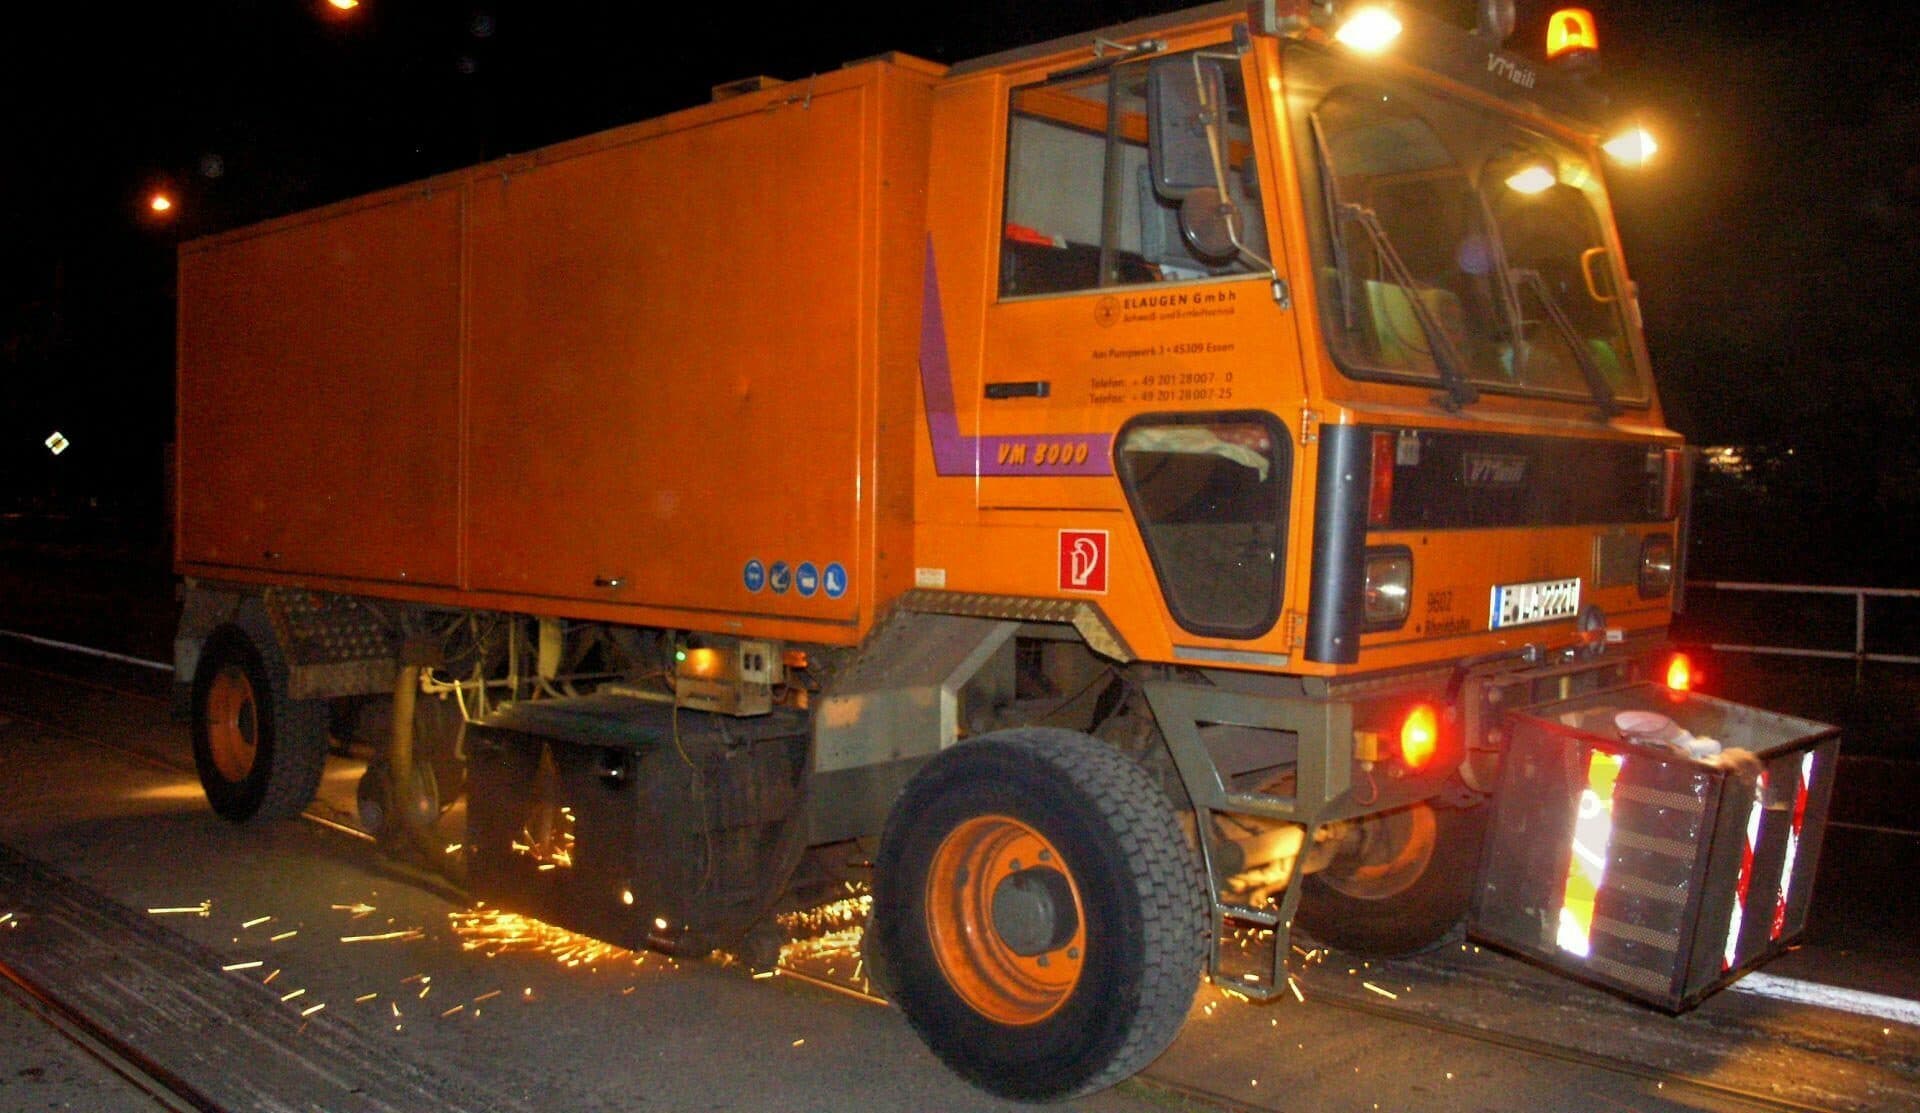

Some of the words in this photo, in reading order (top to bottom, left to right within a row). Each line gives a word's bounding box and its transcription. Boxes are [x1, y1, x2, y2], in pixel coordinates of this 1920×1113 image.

[1124, 293, 1188, 310] ELAUGEN
[1206, 341, 1235, 352] Essen
[1141, 374, 1155, 386] 49
[1157, 373, 1176, 386] 201
[997, 441, 1028, 466] VM
[1033, 440, 1090, 467] 8000
